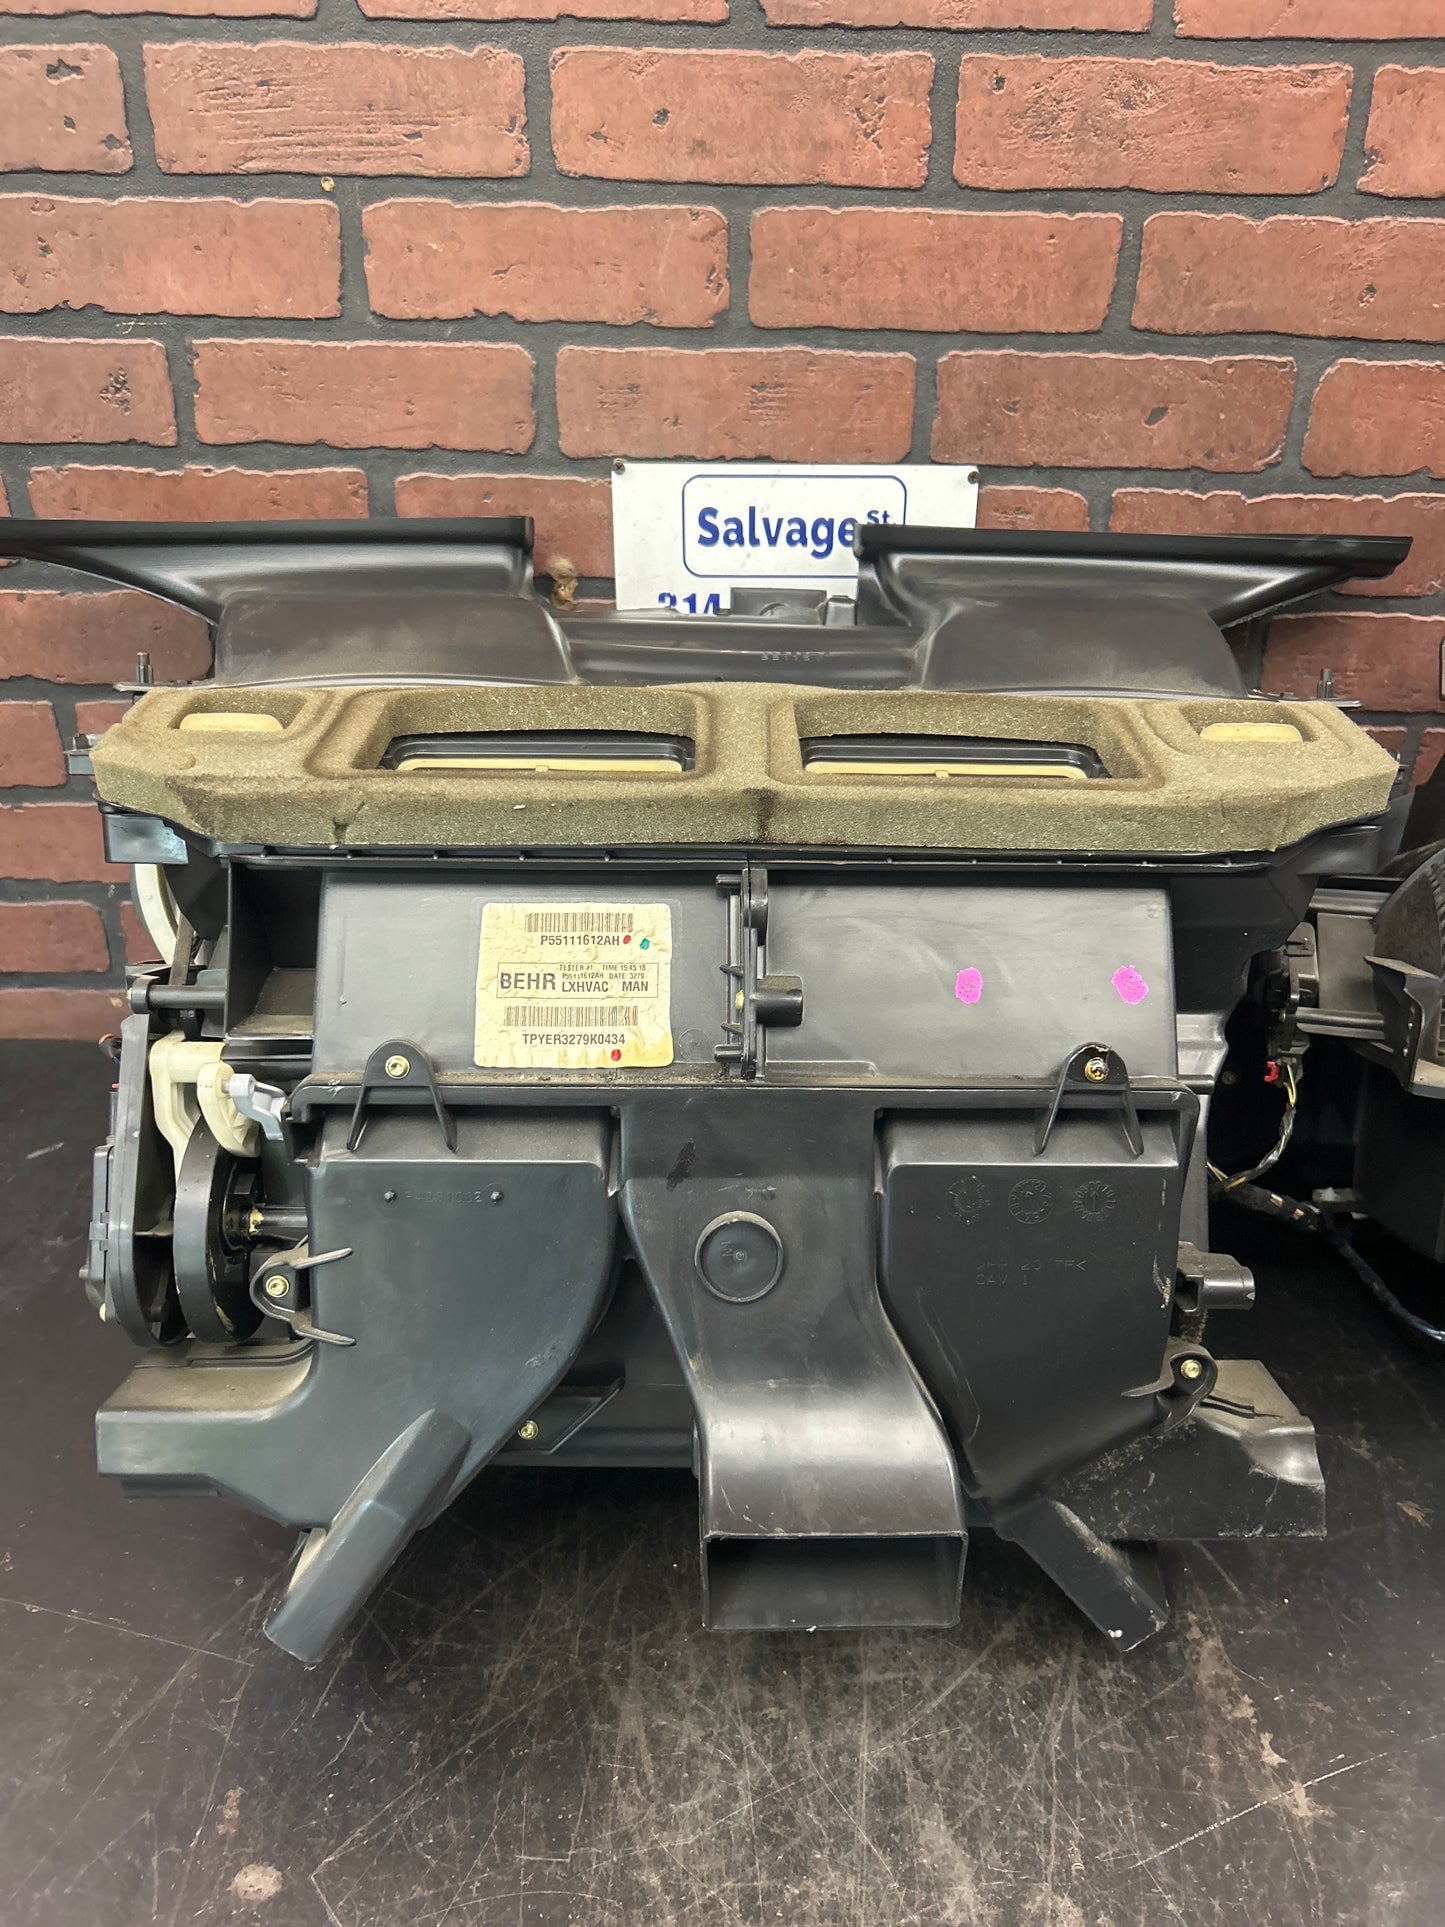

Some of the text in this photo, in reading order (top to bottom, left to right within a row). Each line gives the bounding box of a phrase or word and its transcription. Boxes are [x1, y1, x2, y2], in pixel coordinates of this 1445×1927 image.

[697, 506, 857, 560] Salvage
[540, 934, 620, 946] P55111612AH
[559, 964, 584, 972] TESTER
[500, 972, 556, 991] BEHR
[561, 981, 649, 992] LXHVAC MAN
[522, 1033, 626, 1045] TPYER3279K0434
